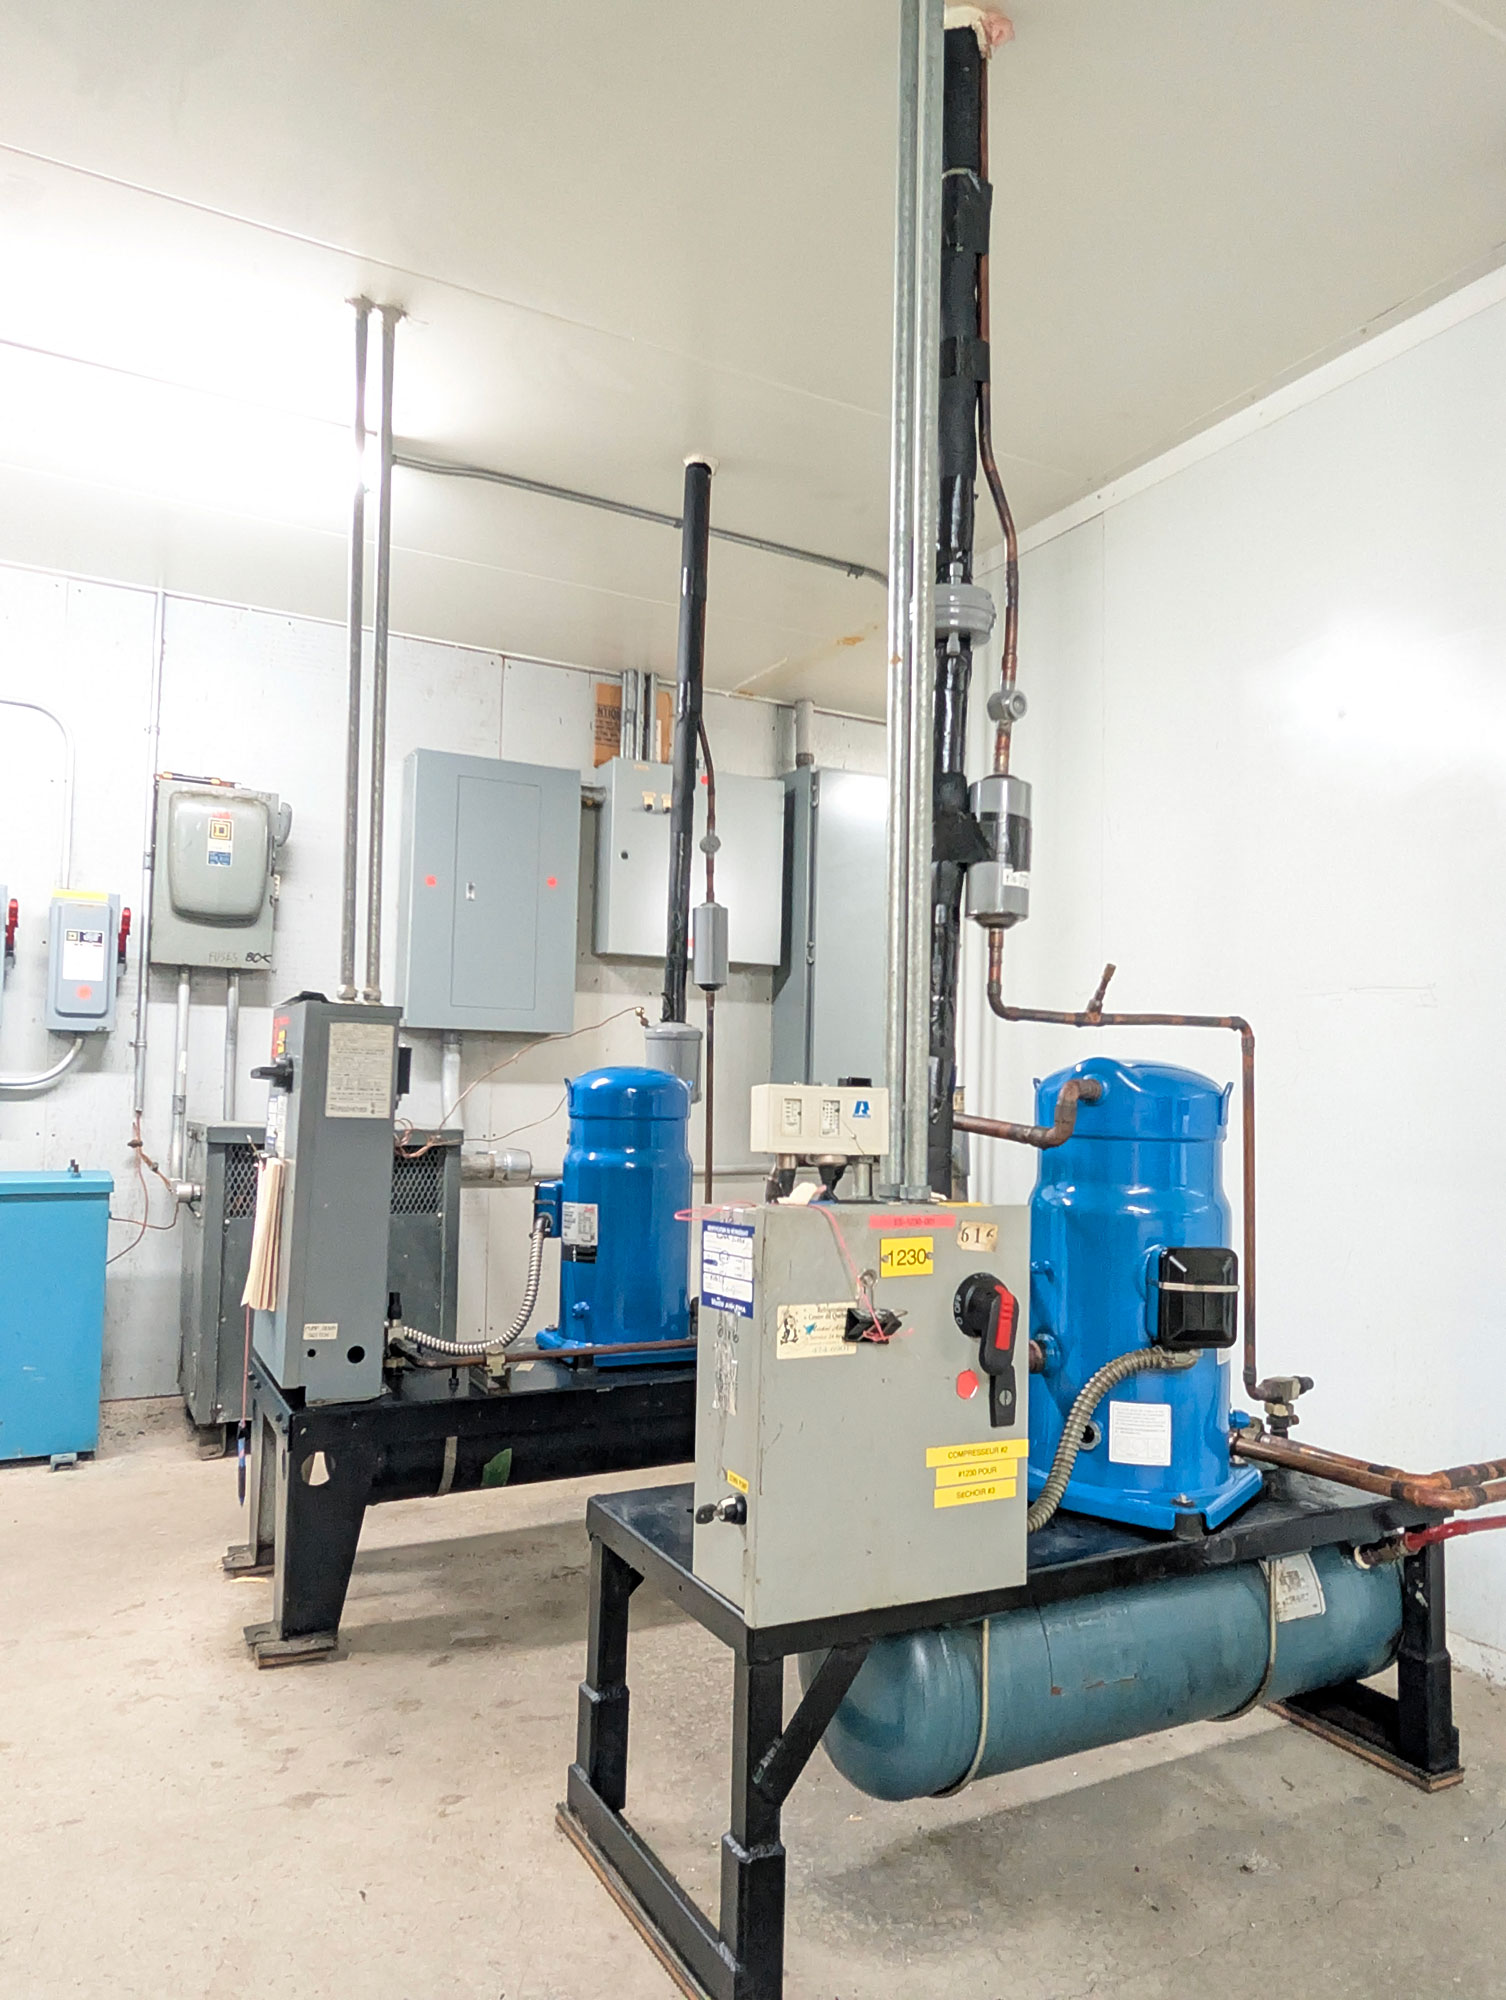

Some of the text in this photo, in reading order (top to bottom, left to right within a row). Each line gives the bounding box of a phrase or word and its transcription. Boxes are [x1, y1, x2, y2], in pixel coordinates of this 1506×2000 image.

[887, 1248, 927, 1267] 1230
[948, 1447, 998, 1459] COMPRESSEUR
[978, 1467, 997, 1475] POUR
